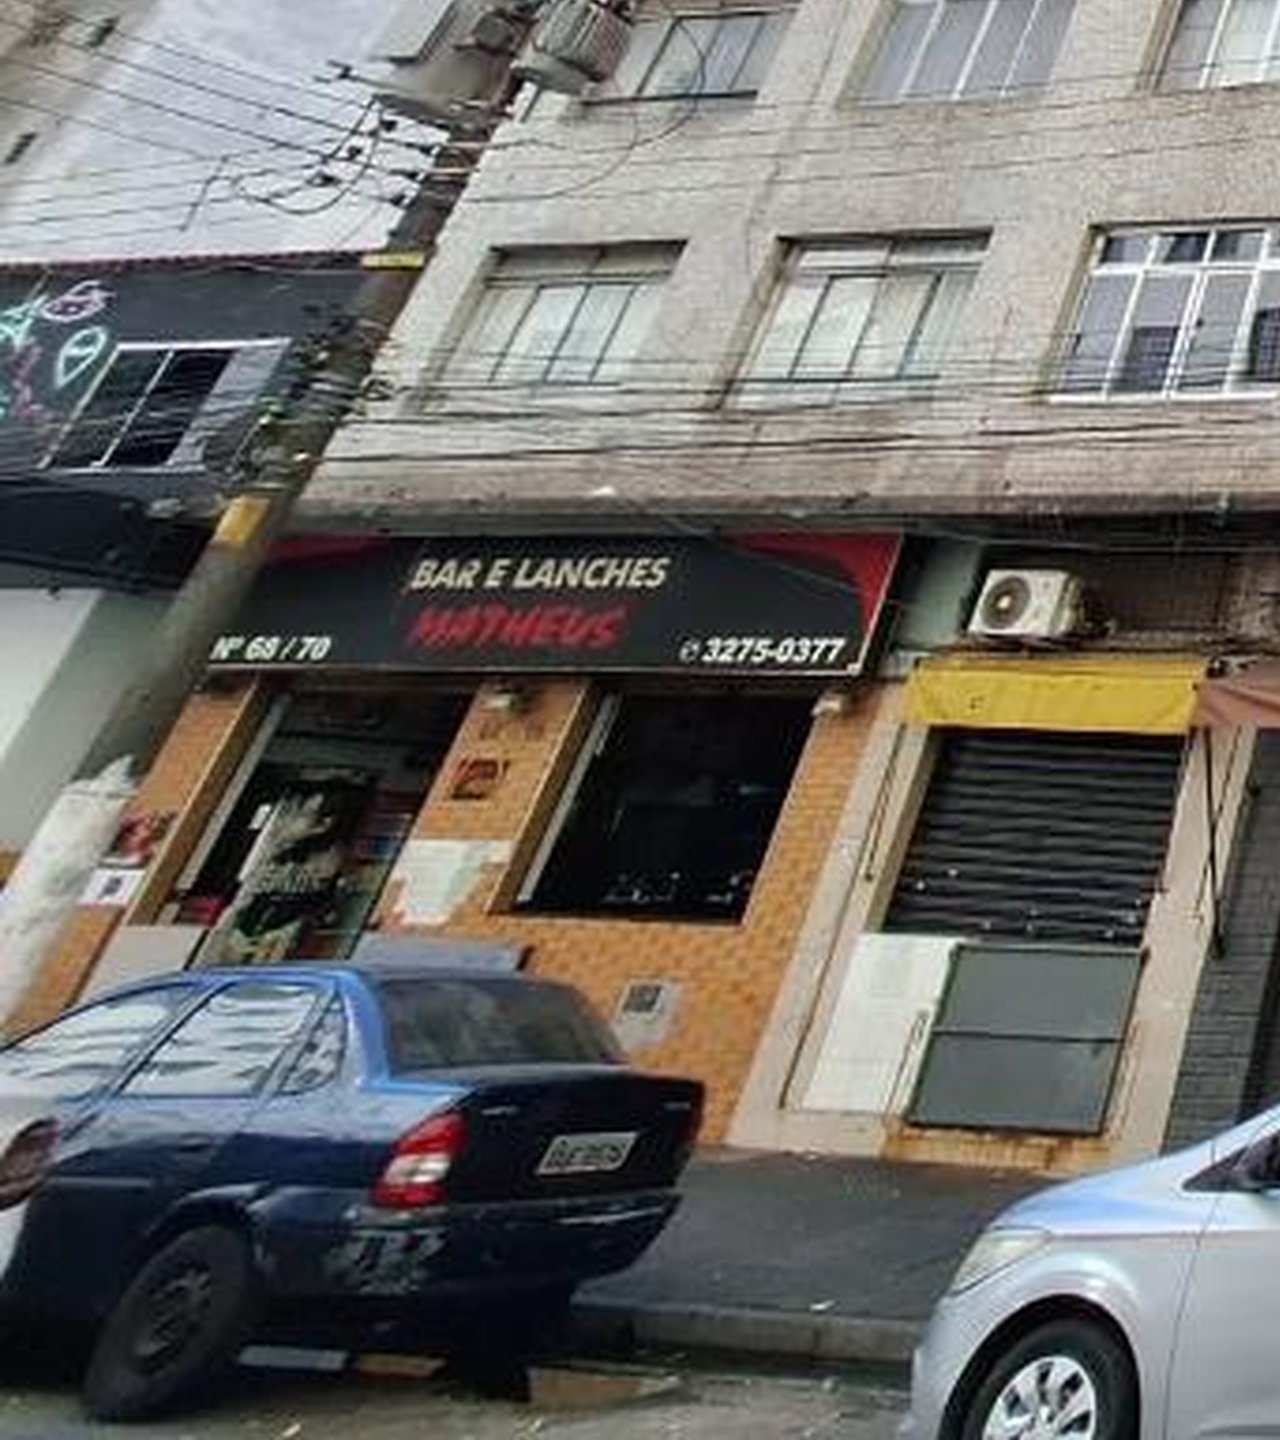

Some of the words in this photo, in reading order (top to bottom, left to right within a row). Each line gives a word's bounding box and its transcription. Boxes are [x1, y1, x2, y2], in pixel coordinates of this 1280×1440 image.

[410, 559, 482, 589] BAR
[484, 559, 512, 588] E
[513, 557, 670, 589] LANCHES
[412, 607, 624, 646] MATHEUS
[245, 635, 281, 661] 68
[296, 635, 332, 661] 70
[701, 636, 846, 662] 3275-0377
